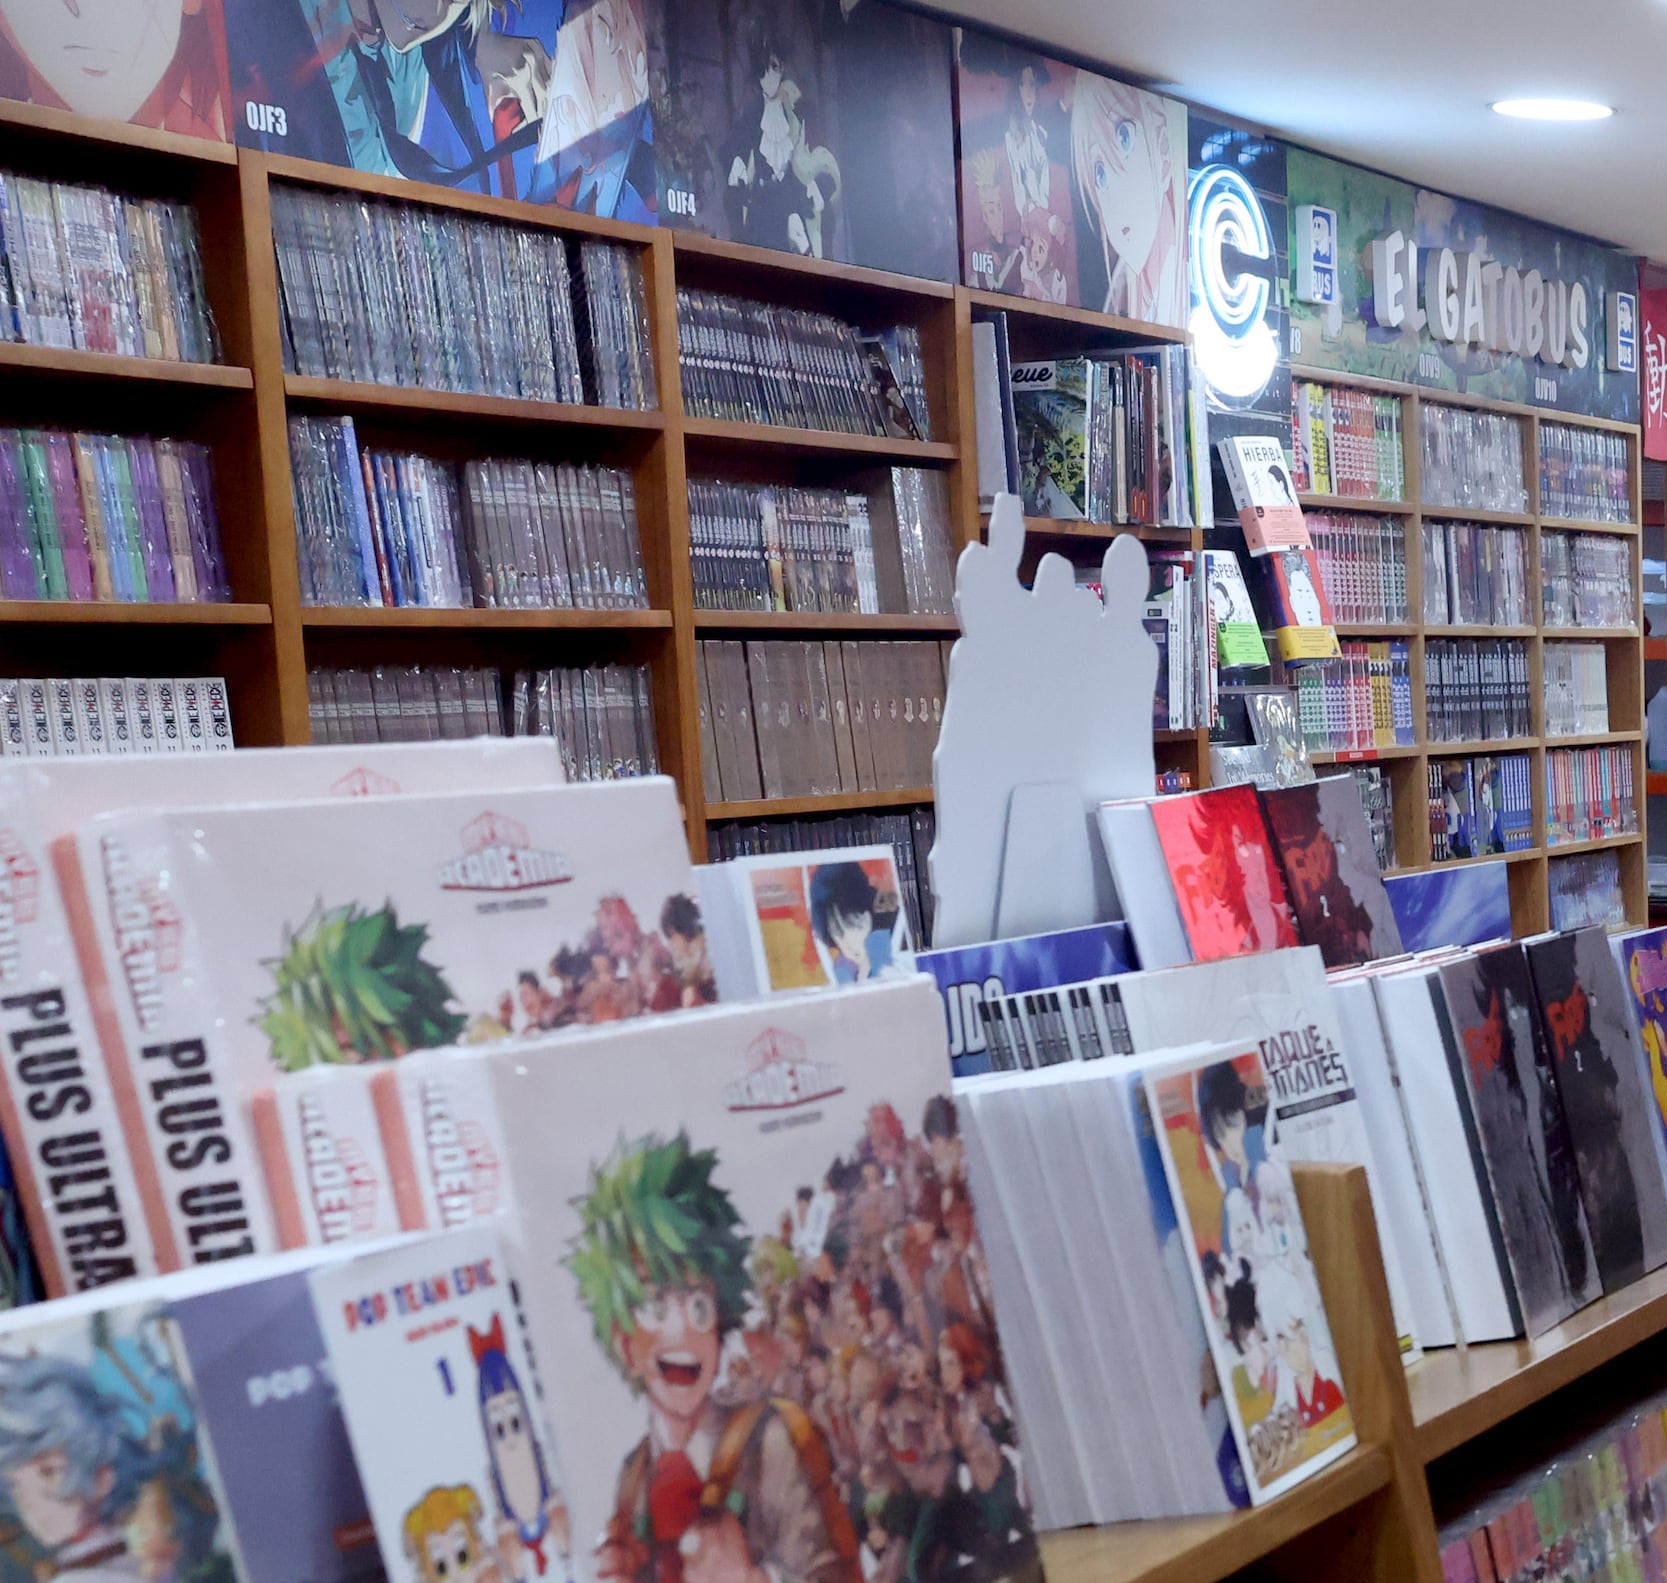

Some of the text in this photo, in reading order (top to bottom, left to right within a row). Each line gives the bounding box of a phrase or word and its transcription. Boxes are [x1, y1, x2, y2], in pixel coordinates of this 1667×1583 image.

[246, 101, 288, 136] OJF3
[667, 187, 697, 217] OJF4
[971, 252, 994, 275] OJF5
[1311, 268, 1333, 300] BUS
[1385, 230, 1588, 369] EL GATOBUS
[1243, 447, 1282, 462] HIERBA
[1269, 1051, 1348, 1099] TITANES
[2, 988, 138, 1291] PLUS ULTRA
[138, 1037, 258, 1266] PLUS ULT
[343, 1257, 499, 1334] POP TEAM EPIC
[437, 1357, 457, 1398] 1
